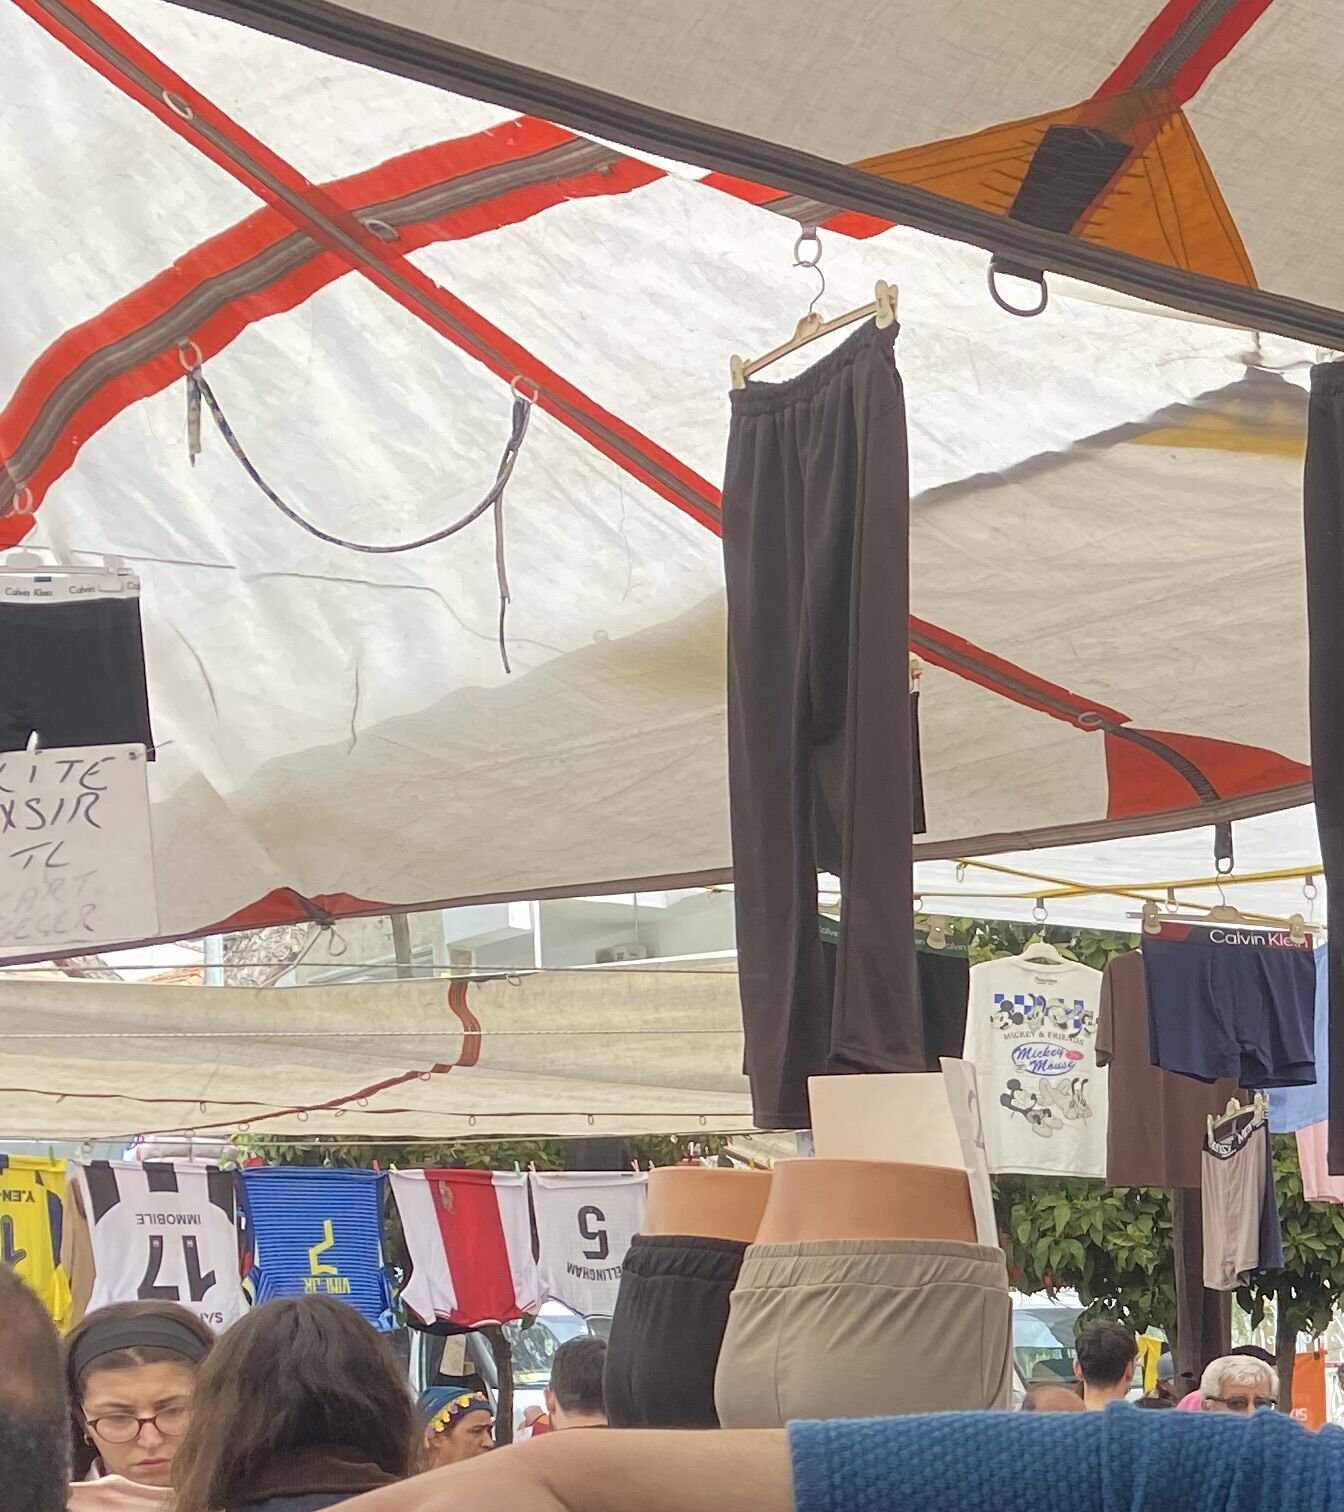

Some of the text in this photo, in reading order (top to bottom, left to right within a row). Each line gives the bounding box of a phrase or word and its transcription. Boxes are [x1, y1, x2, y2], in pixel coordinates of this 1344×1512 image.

[1209, 929, 1265, 946] Calvin
[1016, 1045, 1065, 1060] Mickey
[136, 1213, 202, 1226] IMMOBILE
[577, 1205, 610, 1260] 5
[308, 1219, 338, 1275] 7
[137, 1235, 217, 1302] 17
[566, 1261, 623, 1282] ELLINGHAM
